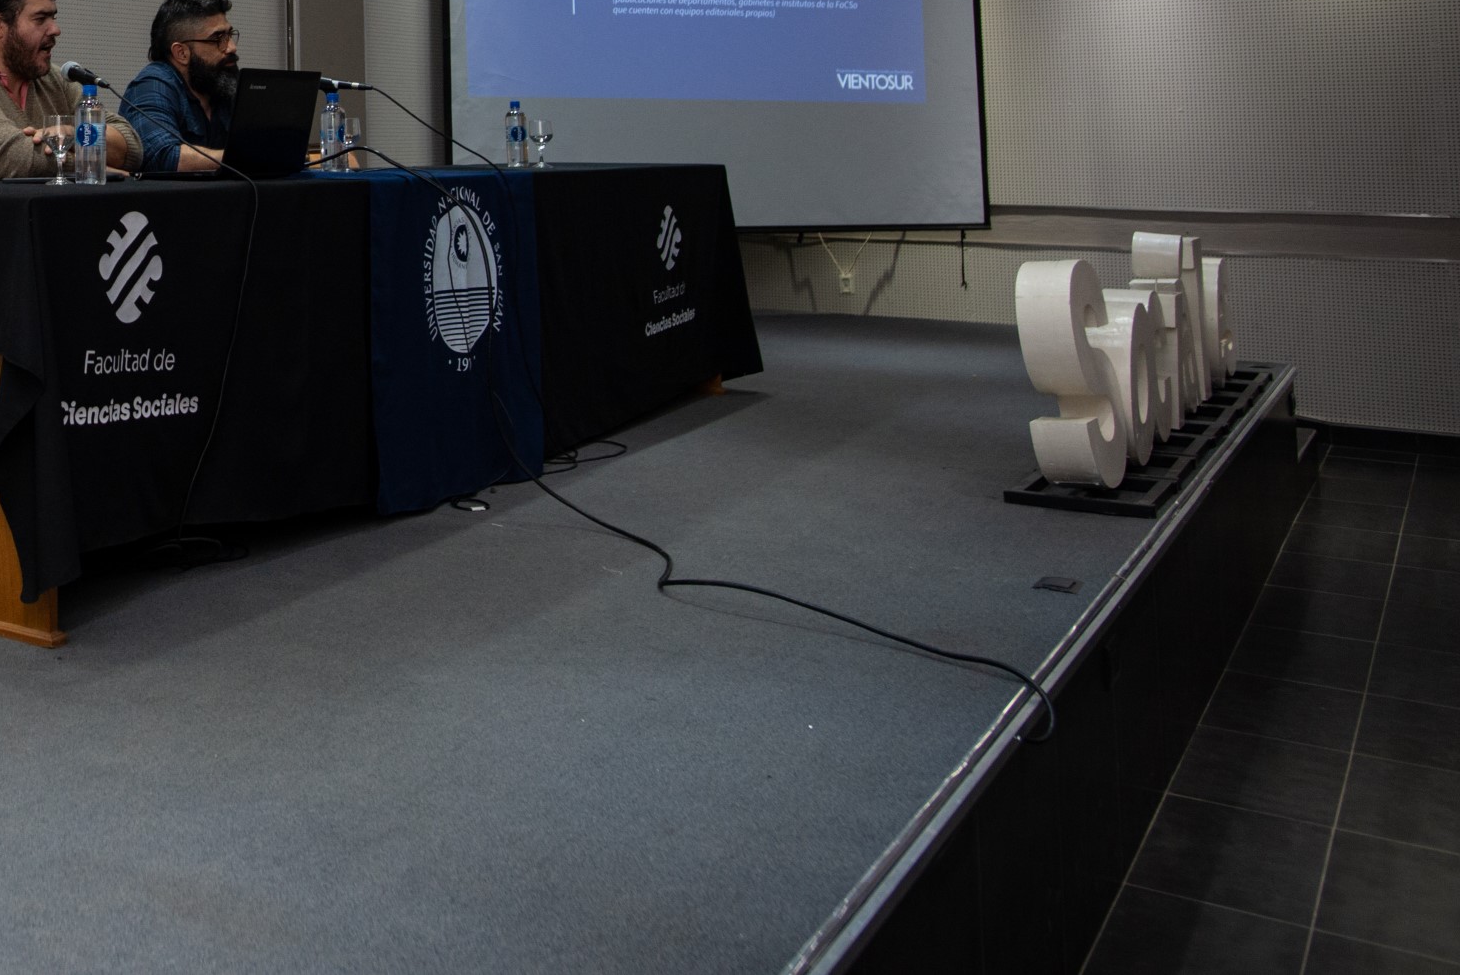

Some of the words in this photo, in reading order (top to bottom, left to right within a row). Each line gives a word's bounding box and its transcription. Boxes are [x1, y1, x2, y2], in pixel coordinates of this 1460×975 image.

[837, 73, 914, 90] VIENTOSUR
[423, 215, 438, 342] UNIVERSIDAD
[482, 210, 496, 236] DE
[645, 316, 672, 337] Ciencias
[84, 348, 150, 375] Facultad
[153, 348, 175, 371] de
[133, 393, 198, 419] Sociales
